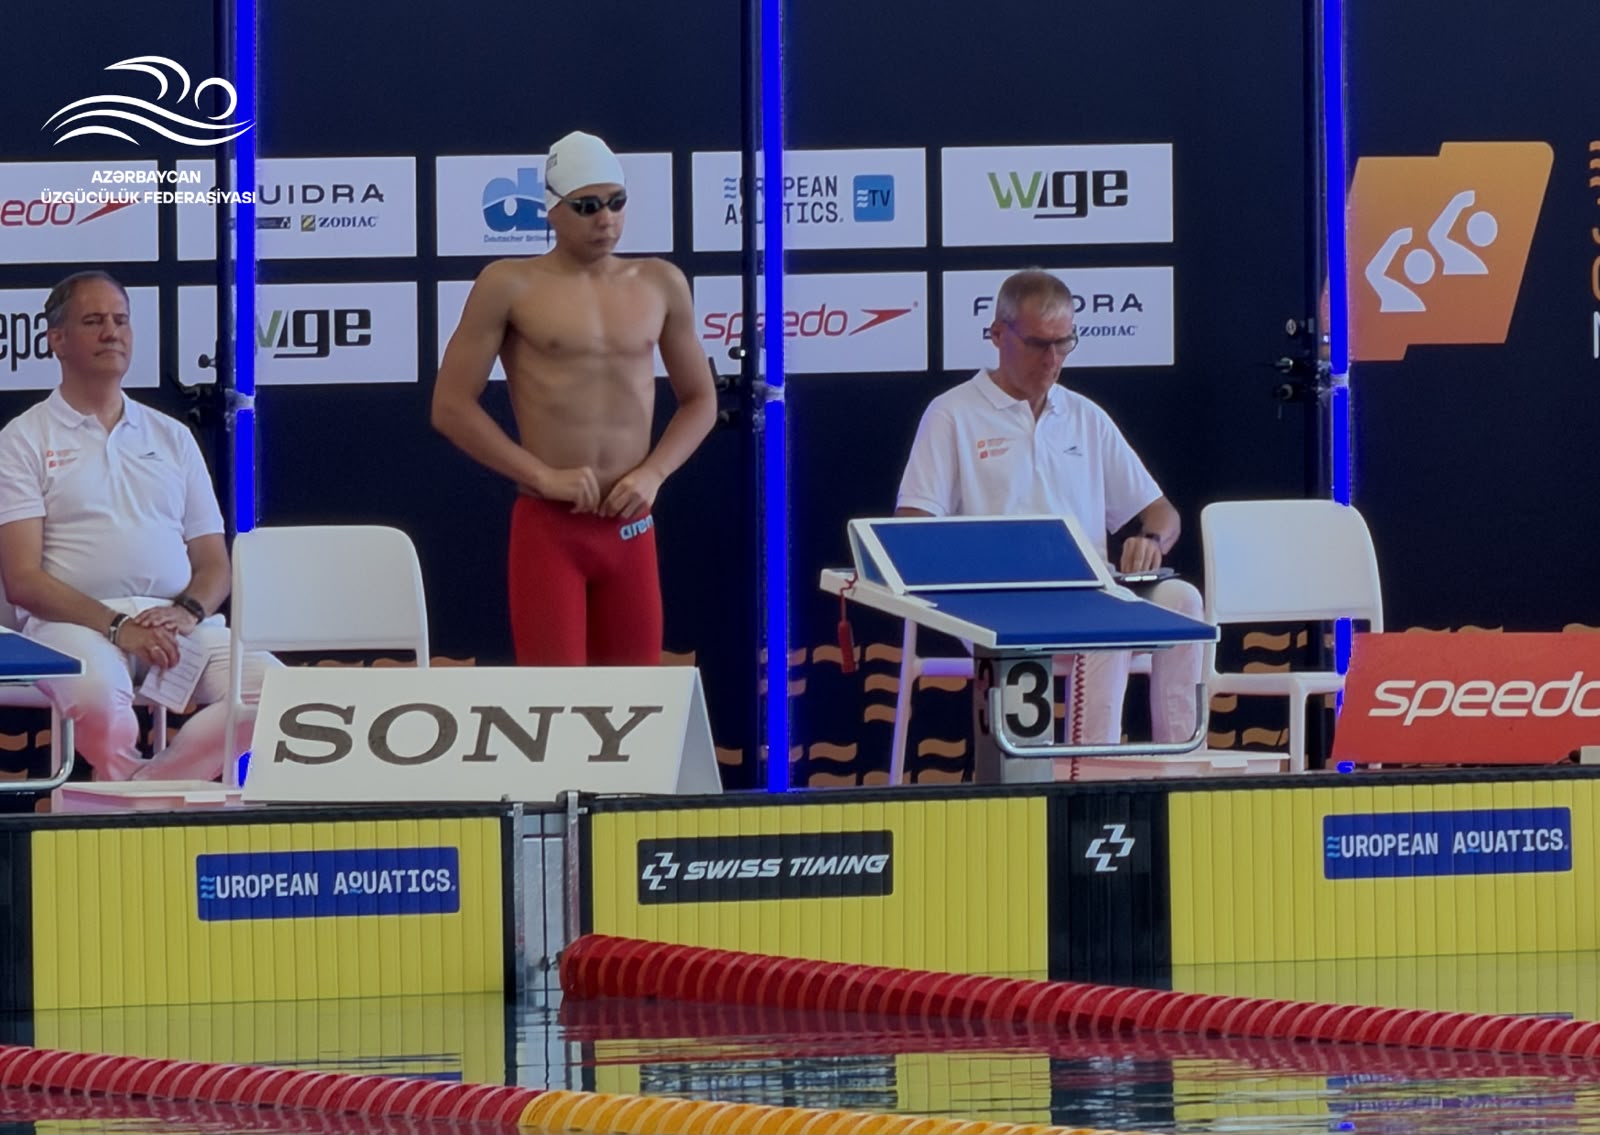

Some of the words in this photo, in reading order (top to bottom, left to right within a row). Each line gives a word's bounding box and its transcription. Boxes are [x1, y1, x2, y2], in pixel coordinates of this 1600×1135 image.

[987, 170, 1128, 219] wige
[319, 215, 377, 228] ZODIAC
[973, 293, 1143, 317] FDRA
[1079, 325, 1136, 337] ZODIAC
[1005, 660, 1052, 738] 3
[274, 702, 664, 765] SONY
[1326, 832, 1439, 859] EUROPEAN
[683, 858, 783, 881] SWISS
[790, 854, 890, 877] TIMING
[200, 872, 319, 899] EUROPEAN
